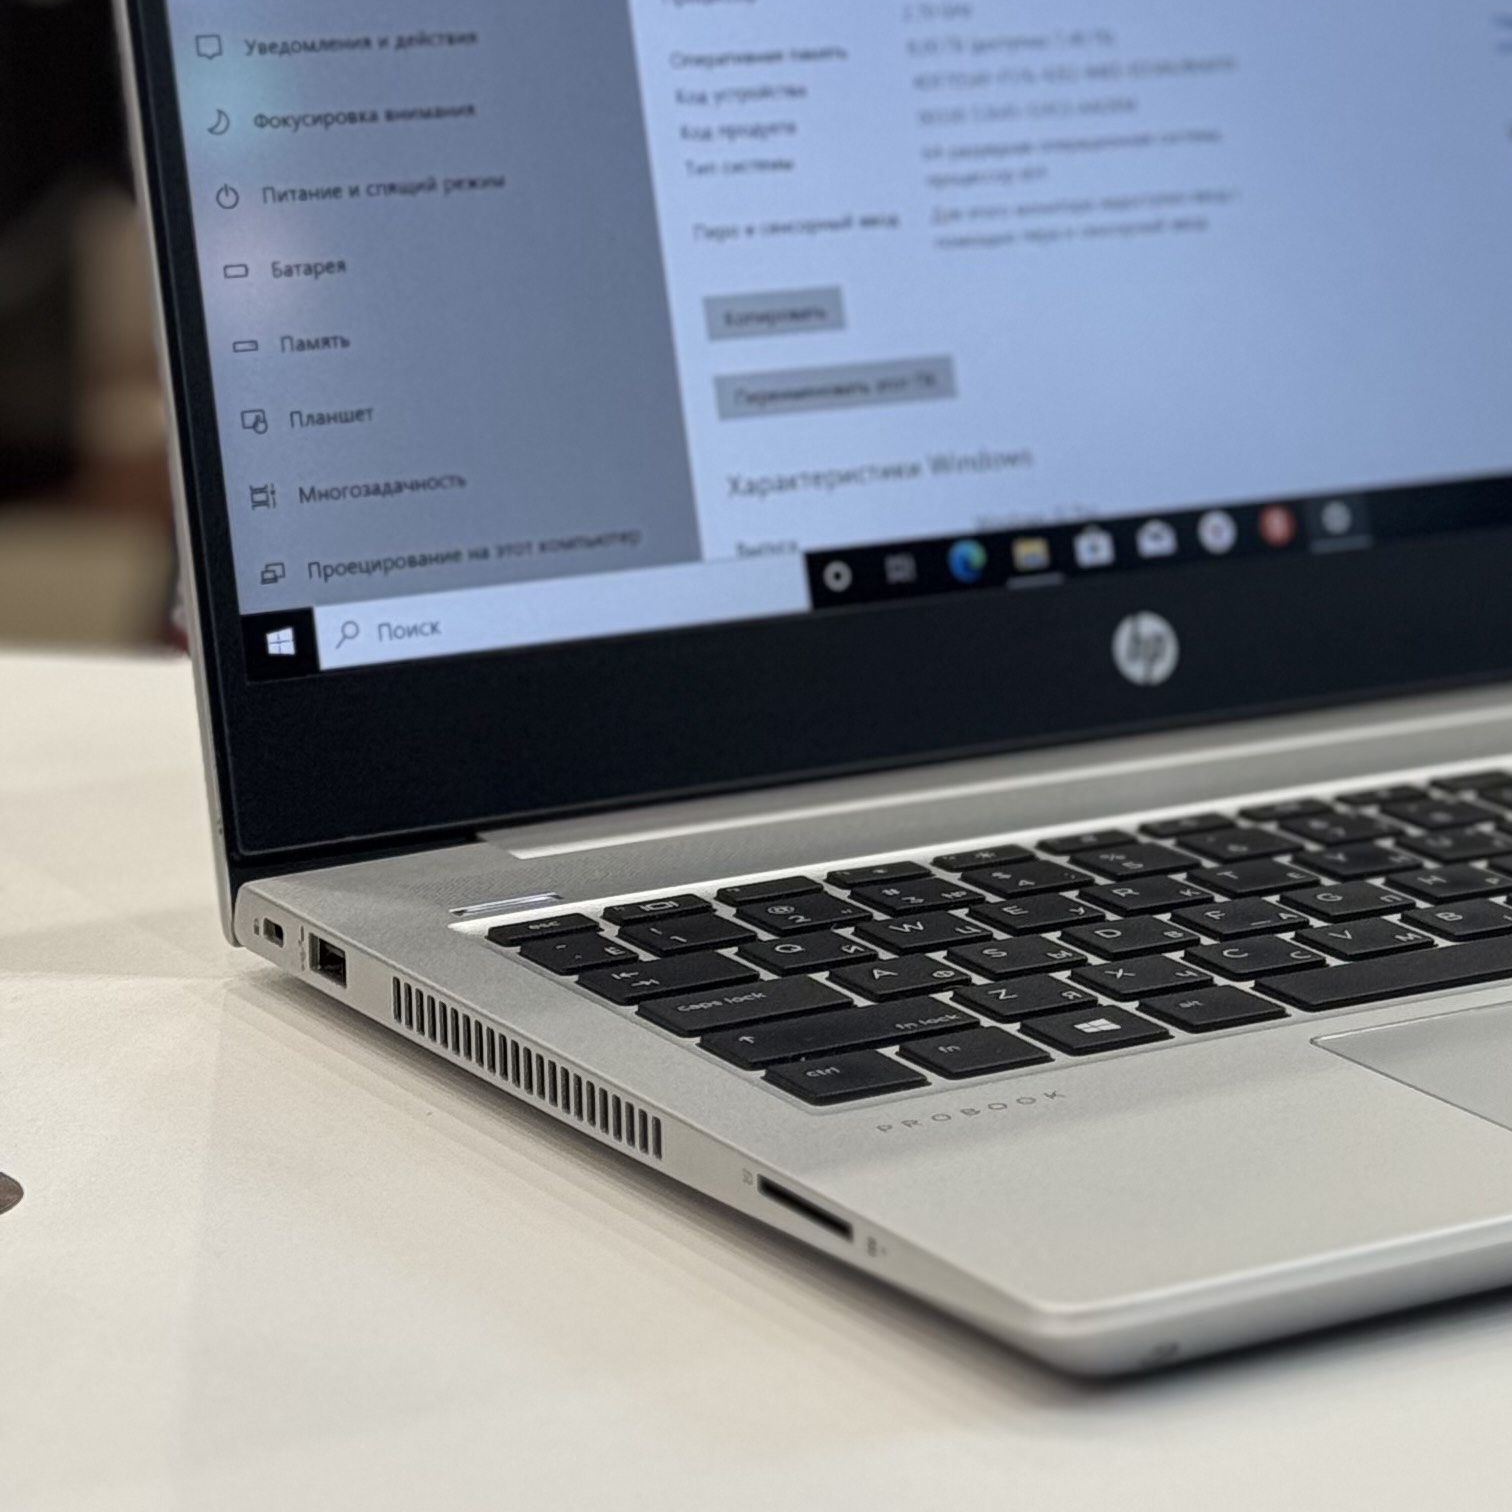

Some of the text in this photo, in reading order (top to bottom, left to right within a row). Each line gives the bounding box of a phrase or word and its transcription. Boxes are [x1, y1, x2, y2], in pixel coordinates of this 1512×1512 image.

[244, 29, 478, 57] Уведомления и действия
[253, 102, 476, 132] Фокусировка внимания
[261, 173, 506, 205] Питание и спящий режим
[270, 257, 347, 280] Батарея
[280, 333, 350, 354] Память
[289, 405, 374, 429] Планшет
[726, 445, 1033, 500] Характеристики Windows
[298, 471, 468, 505] Многозадачность
[307, 527, 642, 582] Проецирование на этот компьютер
[377, 617, 442, 644] Поиск
[1216, 870, 1239, 880] T
[1417, 874, 1447, 886] H
[1111, 888, 1140, 898] R
[1316, 892, 1344, 903] G
[1379, 894, 1403, 904] П
[1001, 904, 1029, 916] E
[1203, 910, 1226, 920] F
[1435, 911, 1464, 922] B
[527, 919, 561, 930] esc
[888, 920, 925, 934] W
[954, 925, 982, 936] Ц
[1094, 928, 1123, 939] D
[1327, 929, 1354, 941] V
[774, 943, 806, 954] Q
[982, 947, 1008, 958] S
[1046, 949, 1073, 960] Ы
[1222, 948, 1250, 959] C
[872, 968, 899, 980] A
[1103, 967, 1137, 980] X
[1175, 969, 1199, 979] Ч
[986, 988, 1019, 1000] Z
[1060, 990, 1083, 1000] Я
[676, 990, 768, 1014] caps lock
[895, 1012, 961, 1031] fn lock
[936, 1043, 962, 1055] fn
[805, 1064, 841, 1078] ctrl
[875, 1089, 1067, 1133] PROBOOK
